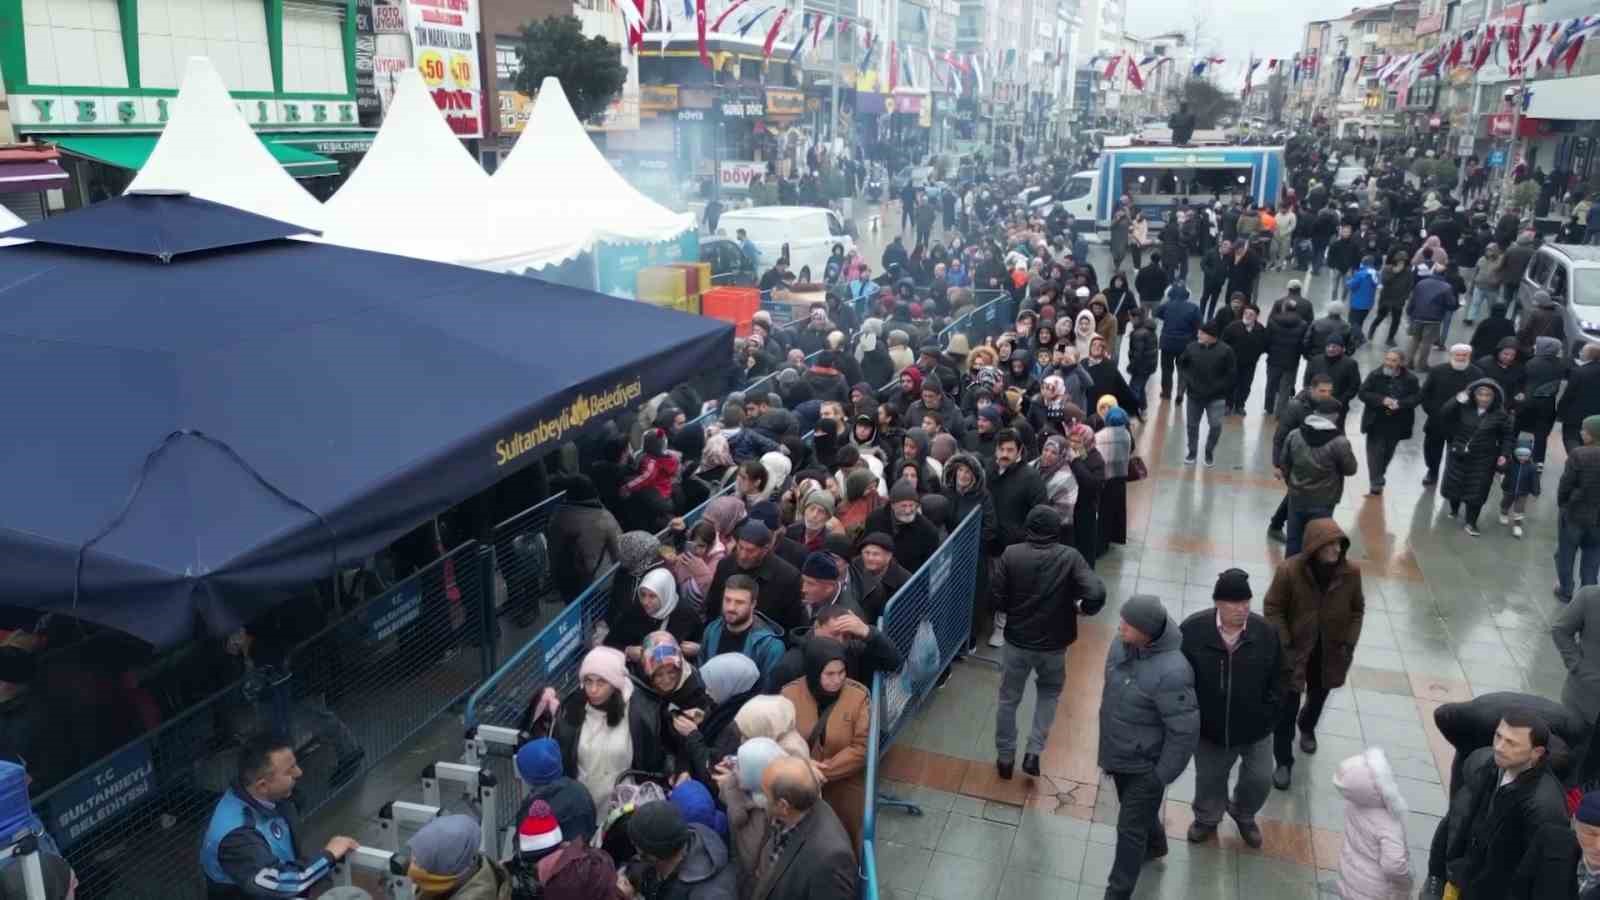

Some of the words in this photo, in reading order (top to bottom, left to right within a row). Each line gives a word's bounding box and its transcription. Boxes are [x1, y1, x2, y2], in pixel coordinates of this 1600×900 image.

[377, 7, 399, 18] FOTO
[496, 408, 570, 466] Sultanbeyli
[590, 375, 641, 417] Belediyesi
